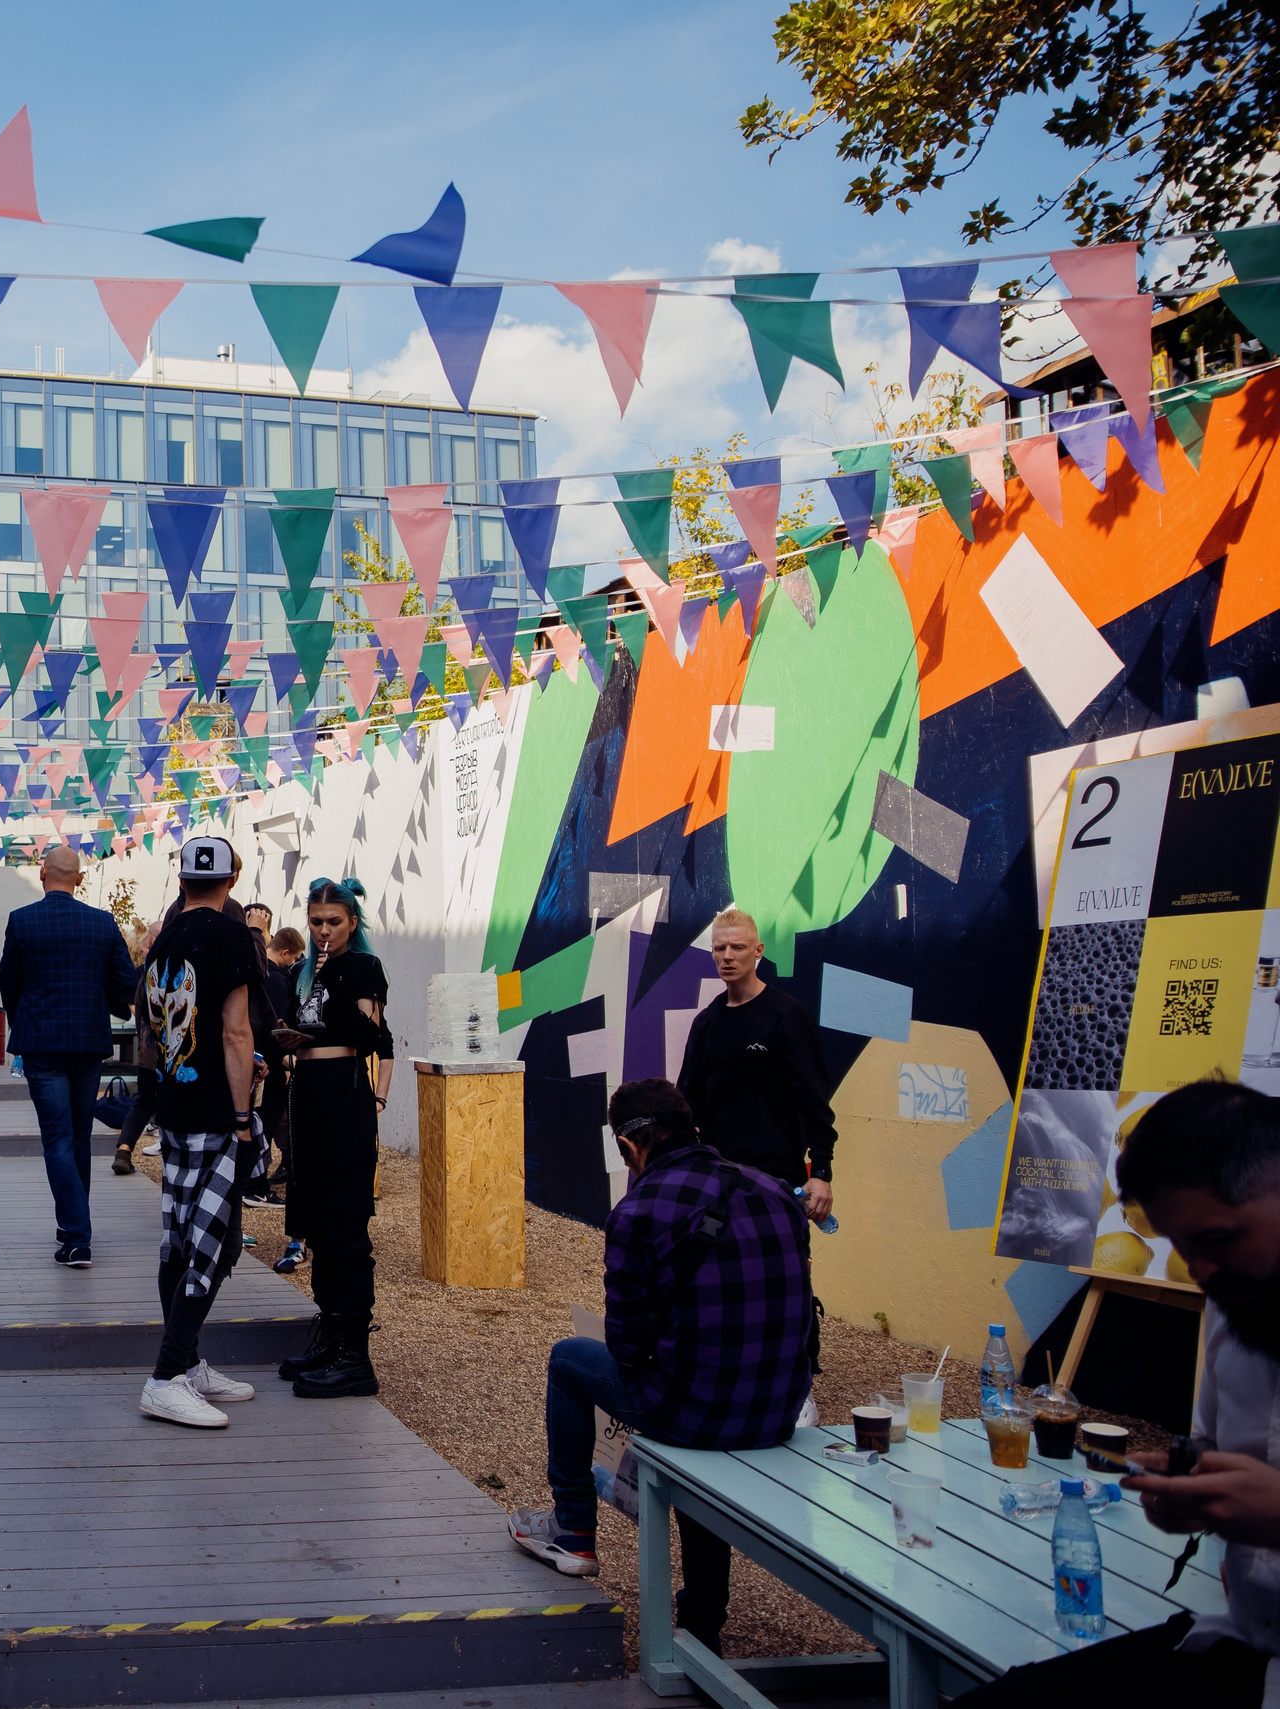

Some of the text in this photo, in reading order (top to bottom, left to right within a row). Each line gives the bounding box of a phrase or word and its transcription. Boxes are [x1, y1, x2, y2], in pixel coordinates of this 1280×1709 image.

[1071, 776, 1120, 850] 2
[1180, 893, 1198, 901] BASED
[1209, 890, 1233, 898] HISTORY
[1169, 958, 1223, 971] FIND US:
[1018, 1157, 1032, 1167] WE
[1033, 1158, 1059, 1169] WANT
[1059, 1159, 1069, 1170] TO
[1015, 1166, 1056, 1179] COCKTAIL
[1020, 1177, 1041, 1187] WITH
[1043, 1179, 1049, 1188] A
[1049, 1179, 1072, 1191] CLEAR
